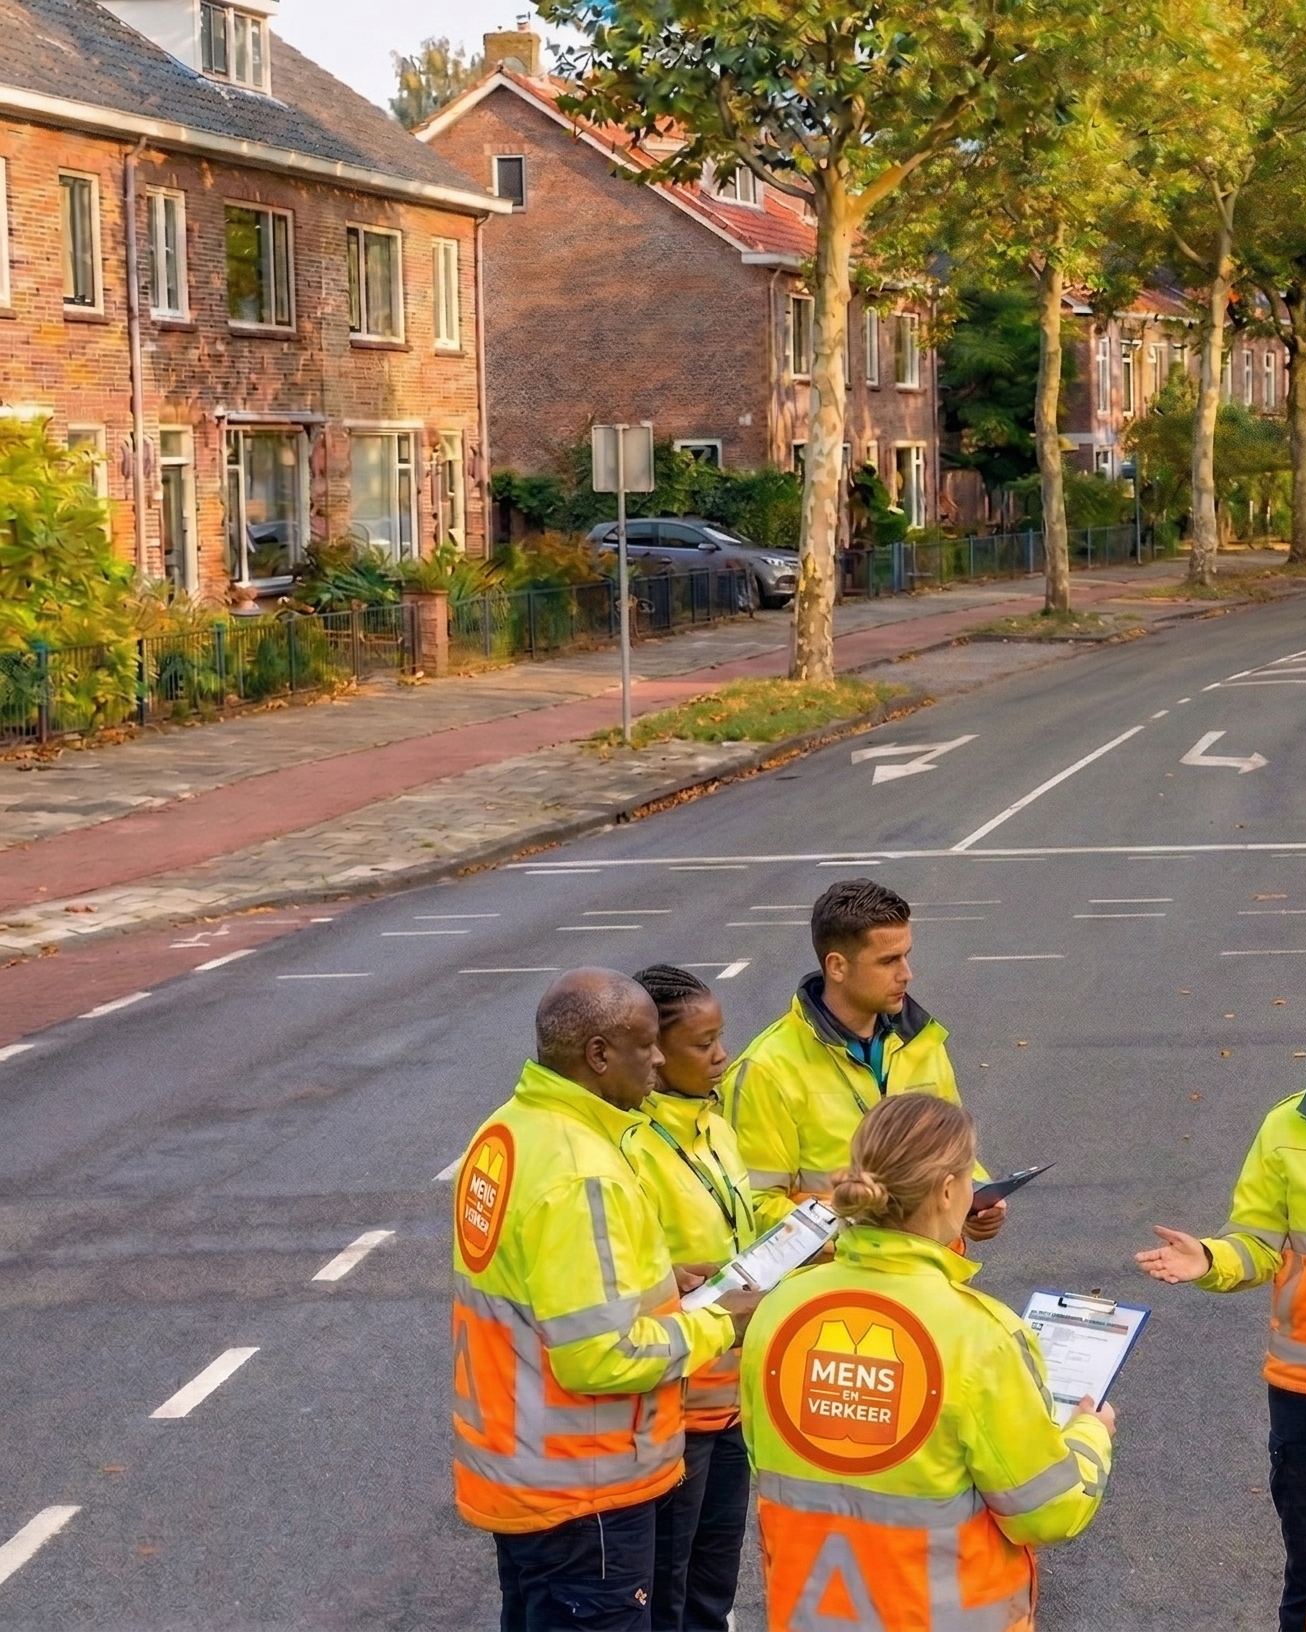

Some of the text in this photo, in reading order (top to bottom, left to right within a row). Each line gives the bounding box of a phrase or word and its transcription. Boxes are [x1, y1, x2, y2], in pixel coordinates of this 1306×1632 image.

[811, 1358, 895, 1393] MENS
[842, 1390, 859, 1401] EN
[808, 1398, 892, 1424] VERKEER
